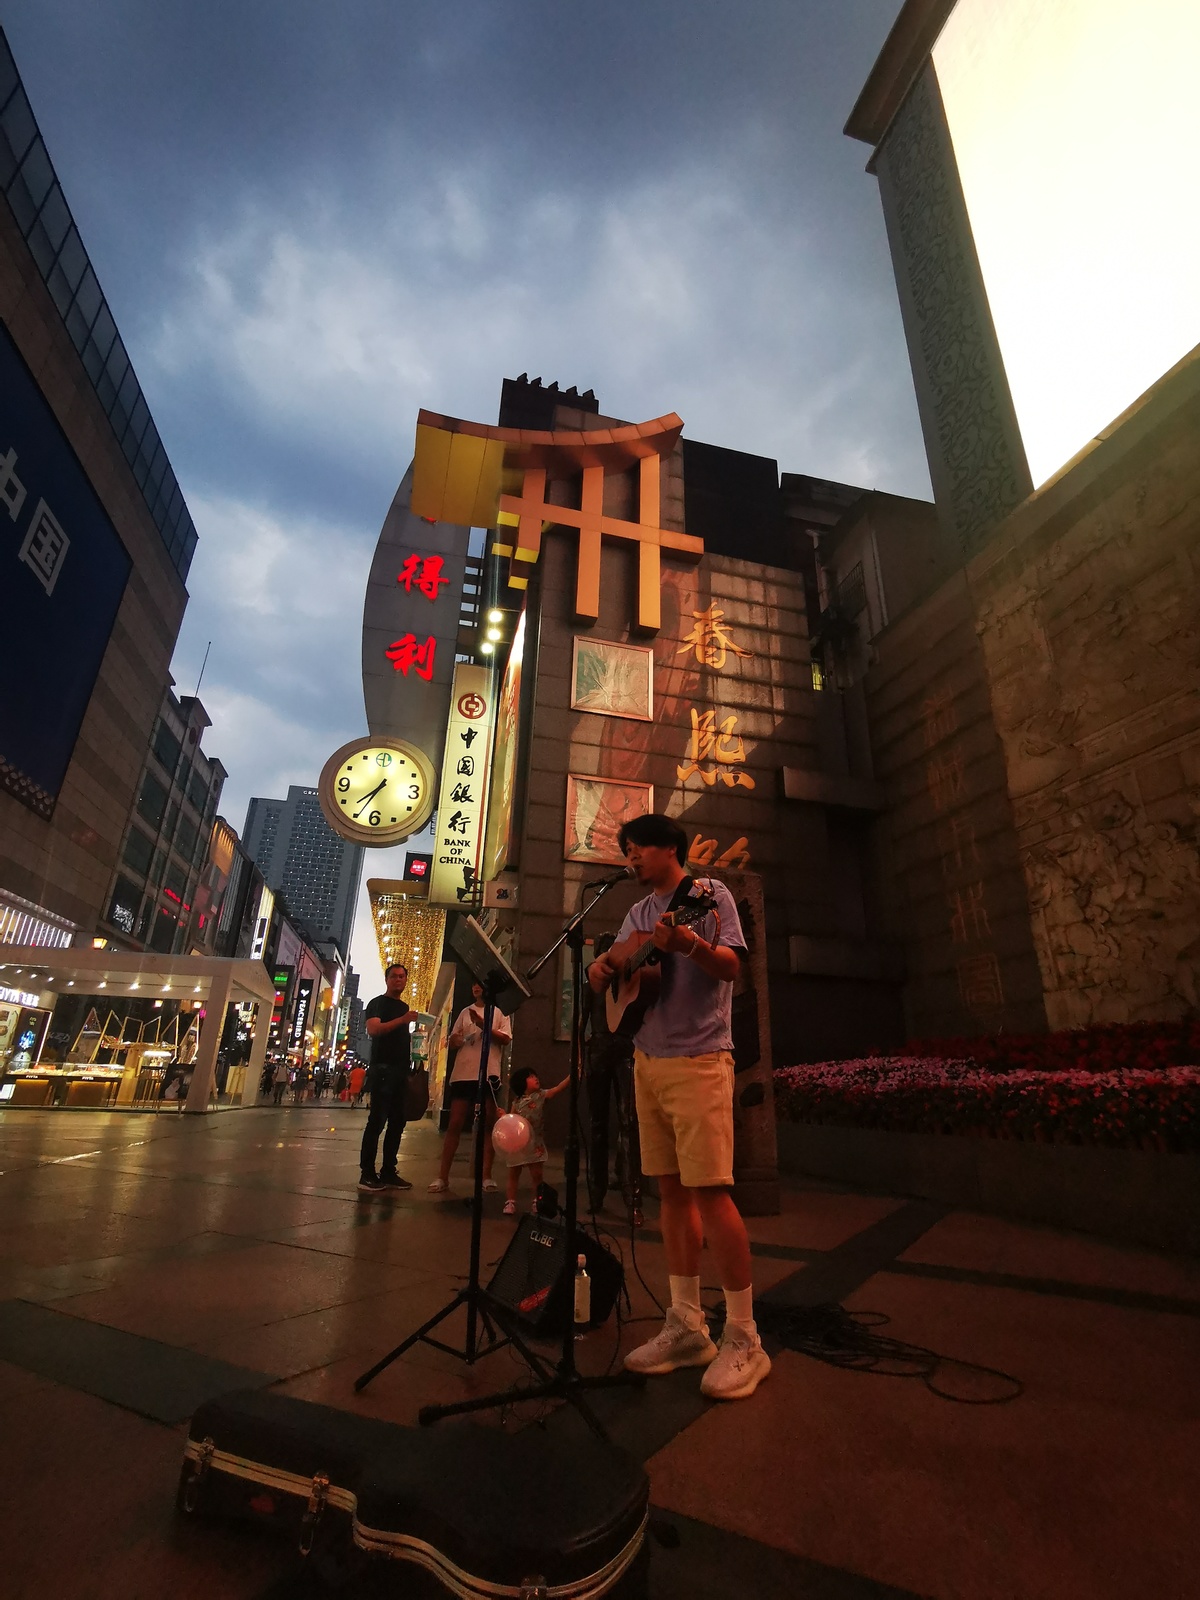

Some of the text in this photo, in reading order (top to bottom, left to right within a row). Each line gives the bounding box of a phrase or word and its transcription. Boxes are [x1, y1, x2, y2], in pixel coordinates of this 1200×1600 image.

[337, 777, 351, 793] 9
[407, 785, 420, 800] 3
[368, 810, 382, 827] 6
[443, 838, 471, 848] BANK
[450, 847, 463, 856] OF
[439, 856, 472, 866] CHINA
[294, 999, 308, 1038] PEACEBIRD
